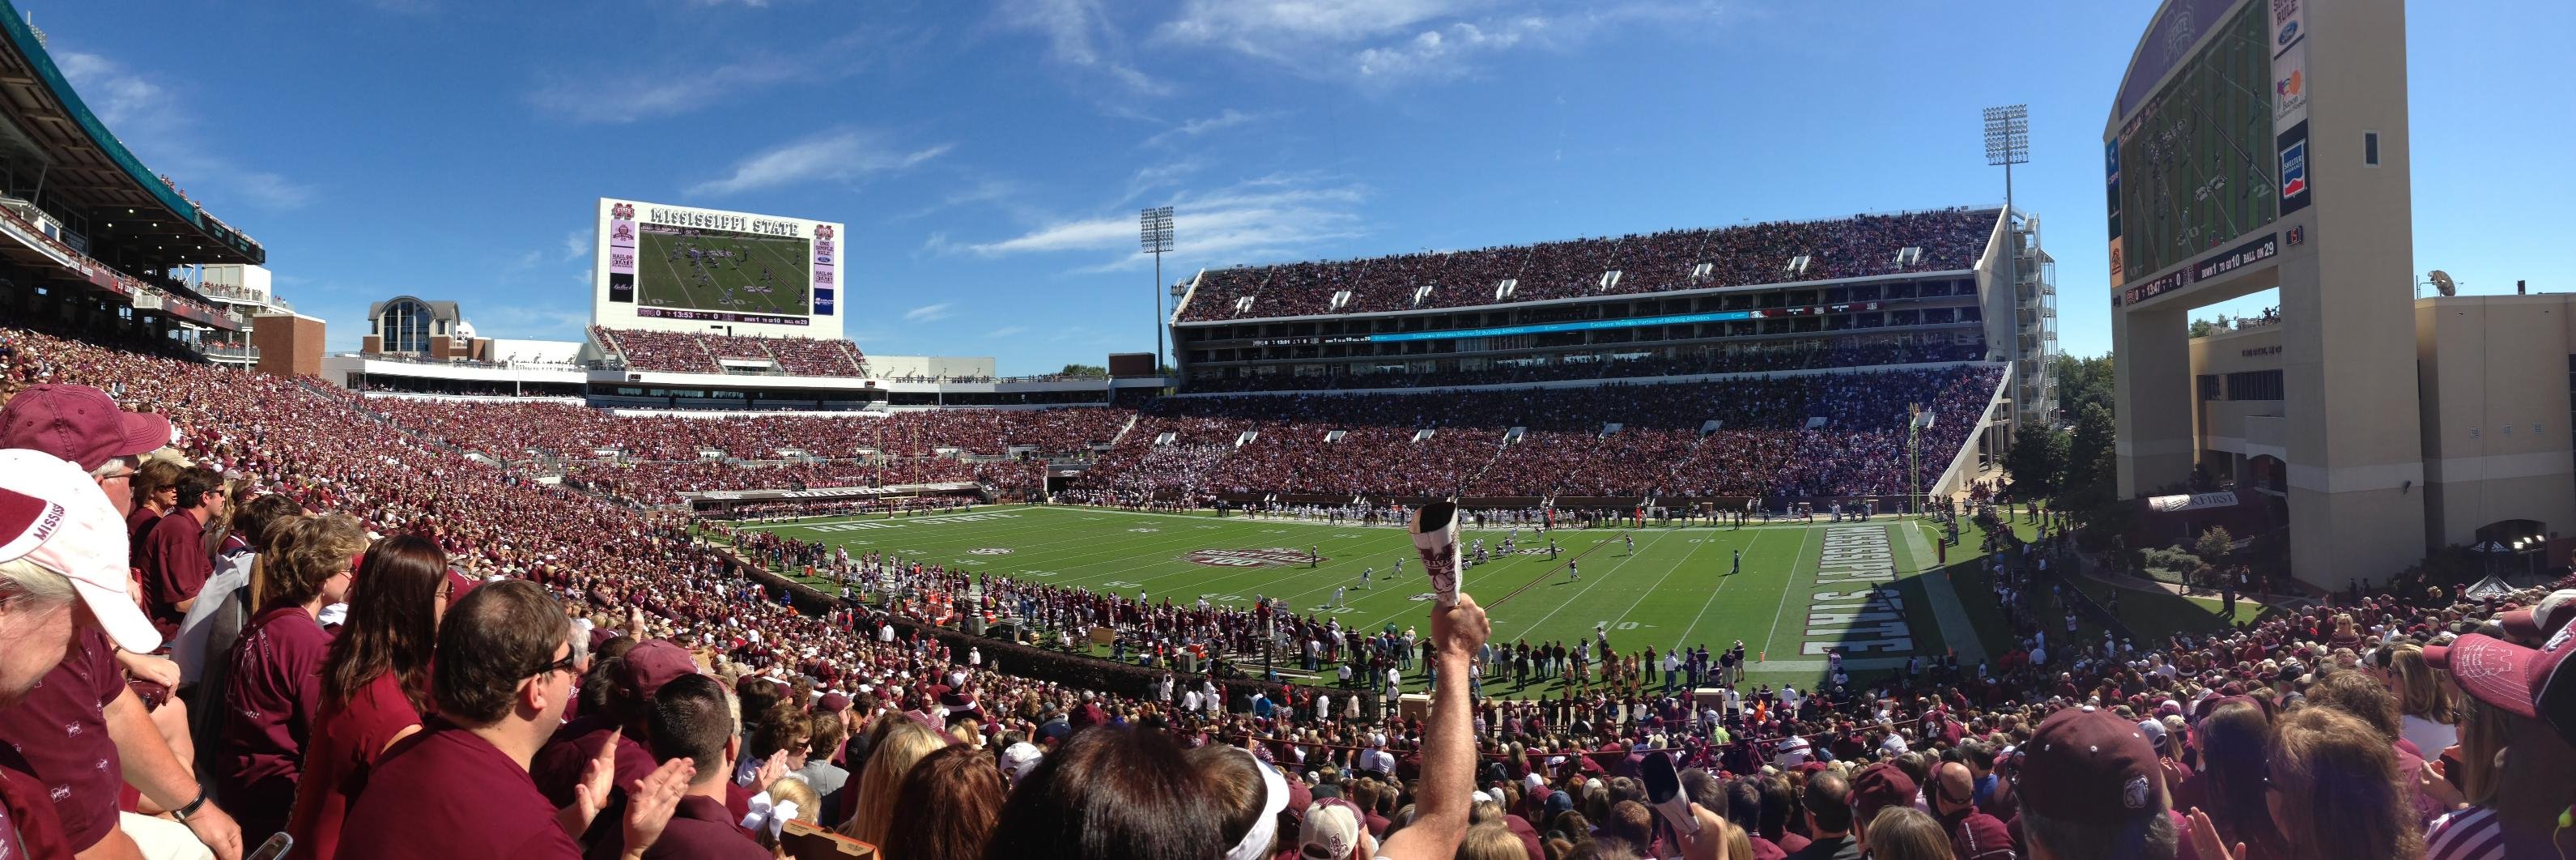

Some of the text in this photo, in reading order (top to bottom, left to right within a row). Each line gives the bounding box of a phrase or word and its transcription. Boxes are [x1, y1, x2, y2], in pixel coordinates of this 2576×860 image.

[2284, 155, 2302, 170] SHELTER
[651, 208, 799, 236] MISSISSIPPI STATE
[2202, 266, 2213, 279] DOWN
[2232, 253, 2240, 268] 10
[2243, 250, 2255, 264] BALL
[2256, 247, 2264, 258] ON
[2264, 241, 2274, 257] 29
[803, 522, 907, 532] HAIL
[1592, 620, 1641, 631] 10
